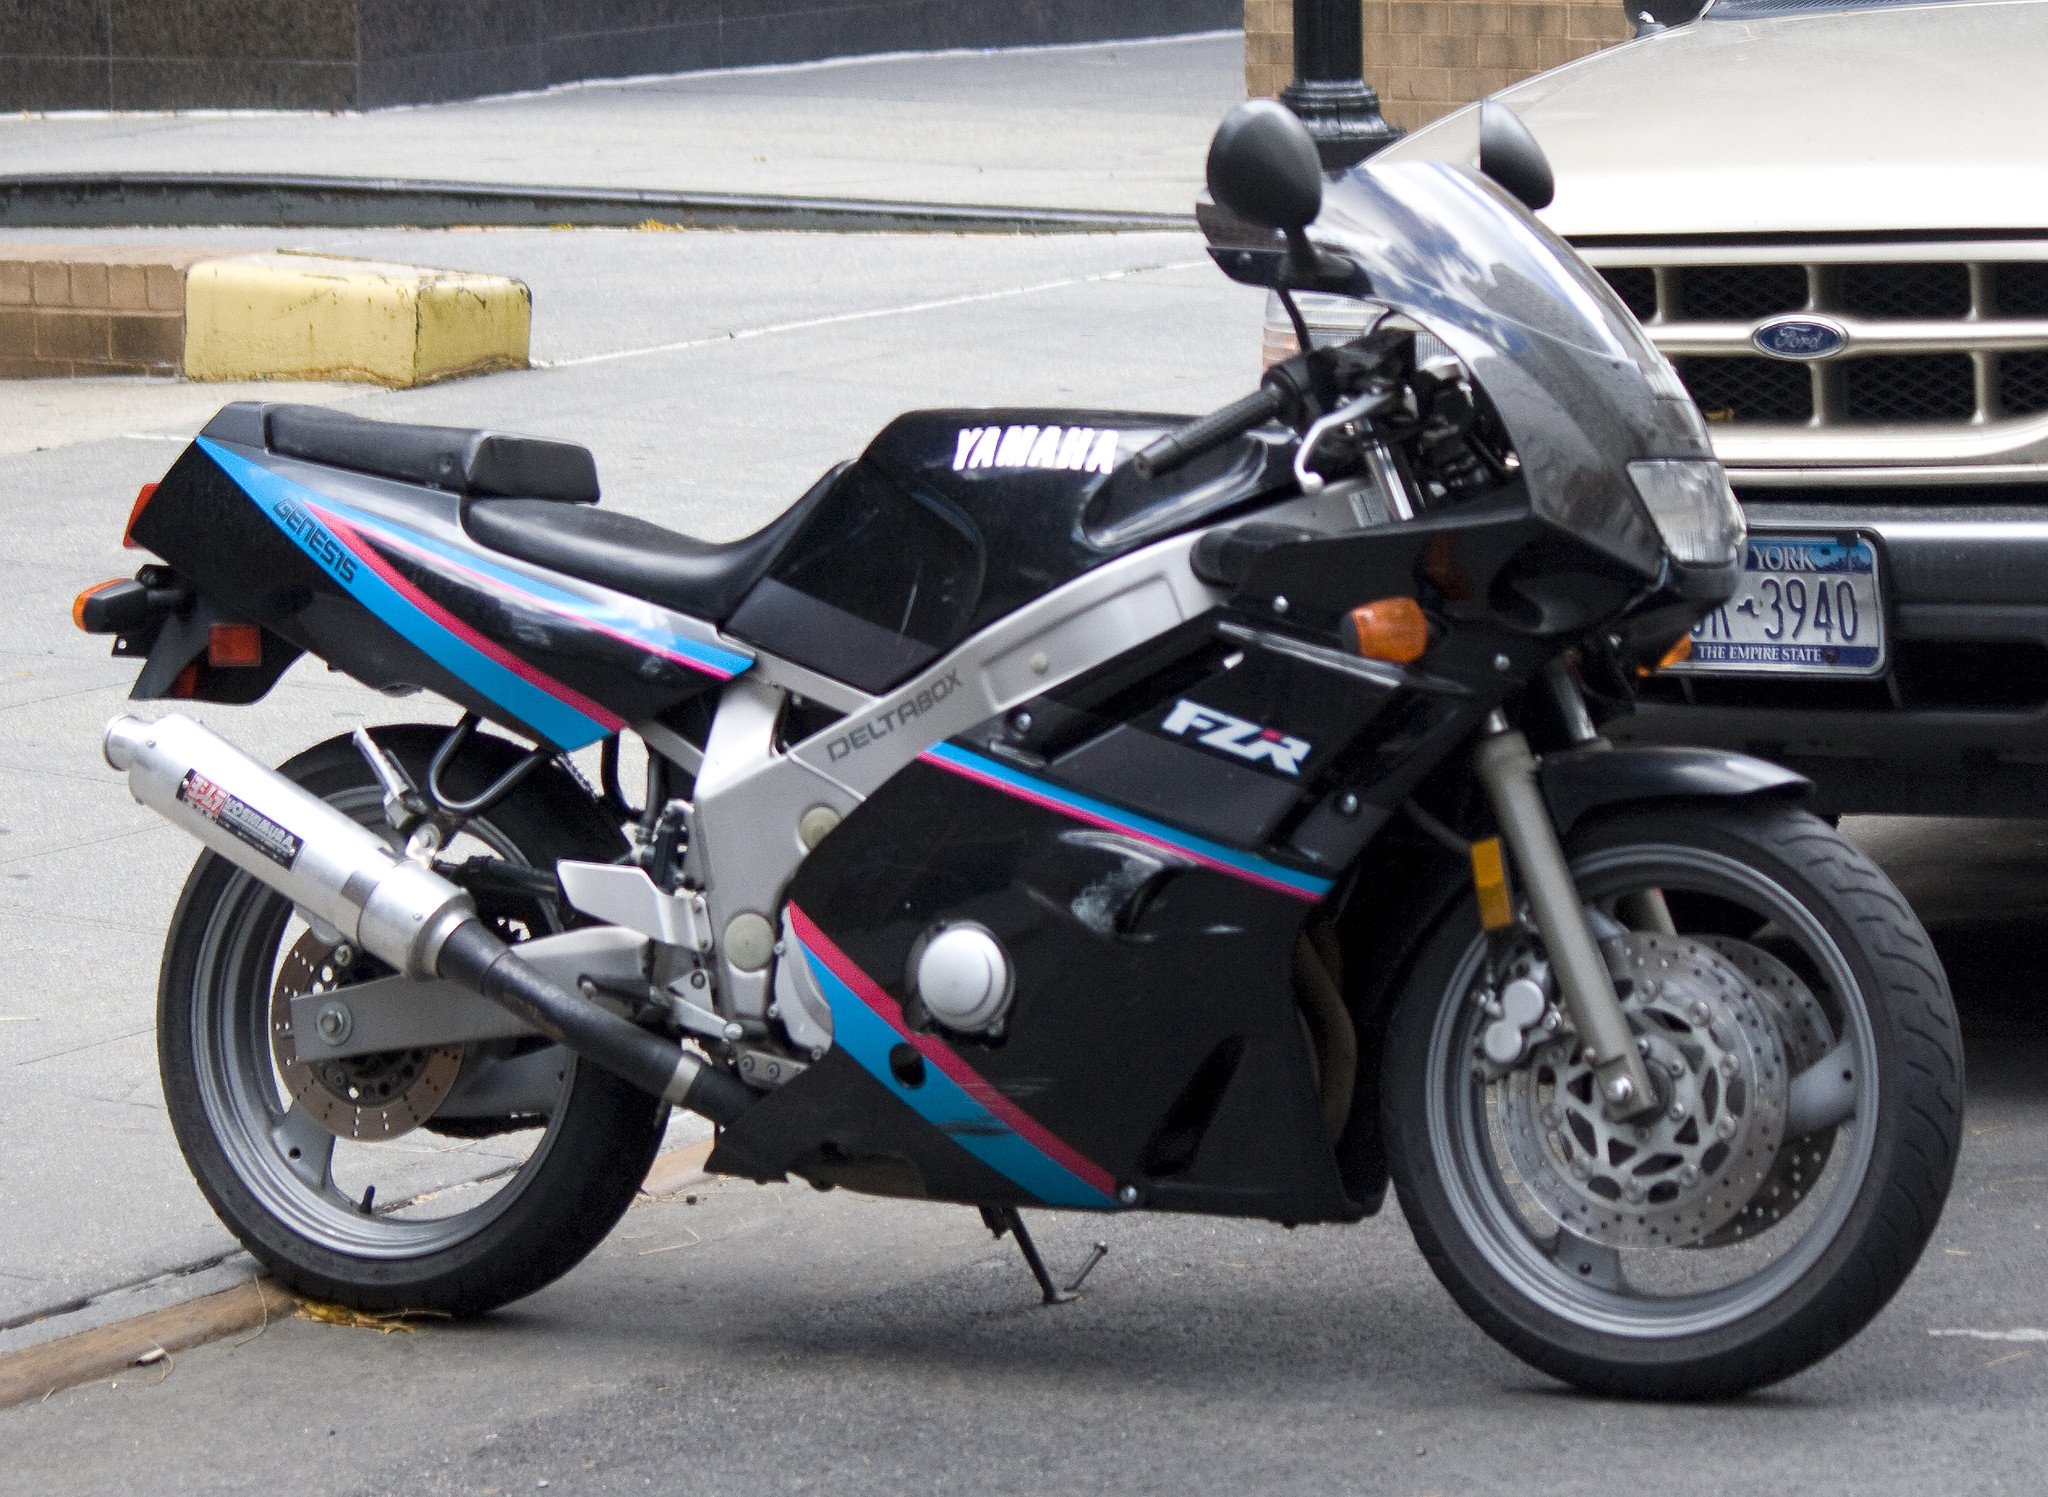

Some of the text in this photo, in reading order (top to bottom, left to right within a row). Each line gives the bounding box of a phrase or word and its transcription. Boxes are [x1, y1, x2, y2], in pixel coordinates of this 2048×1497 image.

[1774, 325, 1823, 348] Ford
[953, 425, 1119, 475] YAMAHA
[273, 498, 358, 583] GENESIS
[1753, 546, 1816, 571] YORK
[1761, 578, 1858, 642] 3940
[1698, 645, 1822, 661] THE EMPIRE STATE
[826, 669, 962, 762] DELTABOX
[1161, 699, 1312, 775] FZR
[222, 797, 295, 851] YOSHIMURA
